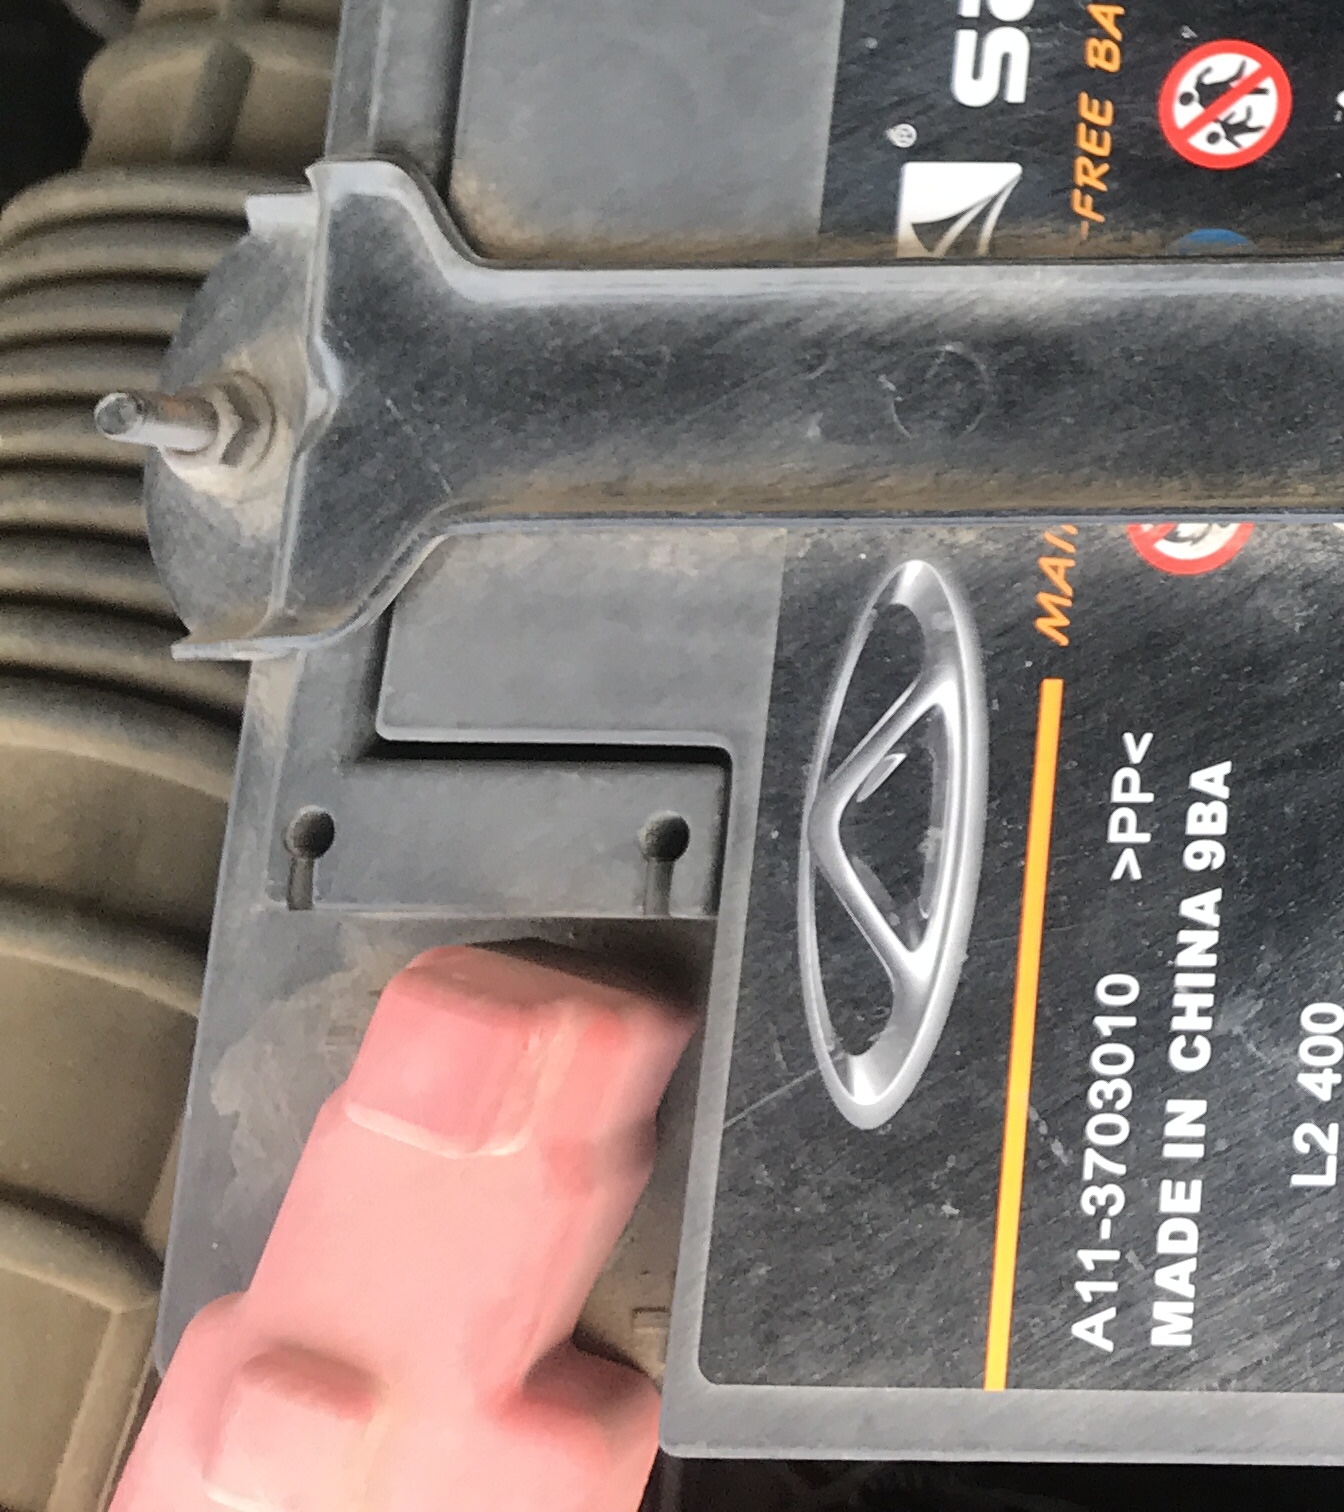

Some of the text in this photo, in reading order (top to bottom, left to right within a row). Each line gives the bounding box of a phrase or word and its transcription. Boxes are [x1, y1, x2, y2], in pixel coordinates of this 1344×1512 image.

[1034, 525, 1078, 646] MAI
[1072, 732, 1154, 1351] A11-3703010 >PP<
[1151, 761, 1232, 1347] MADE IN CHINA 9BA
[1290, 1121, 1338, 1188] L2
